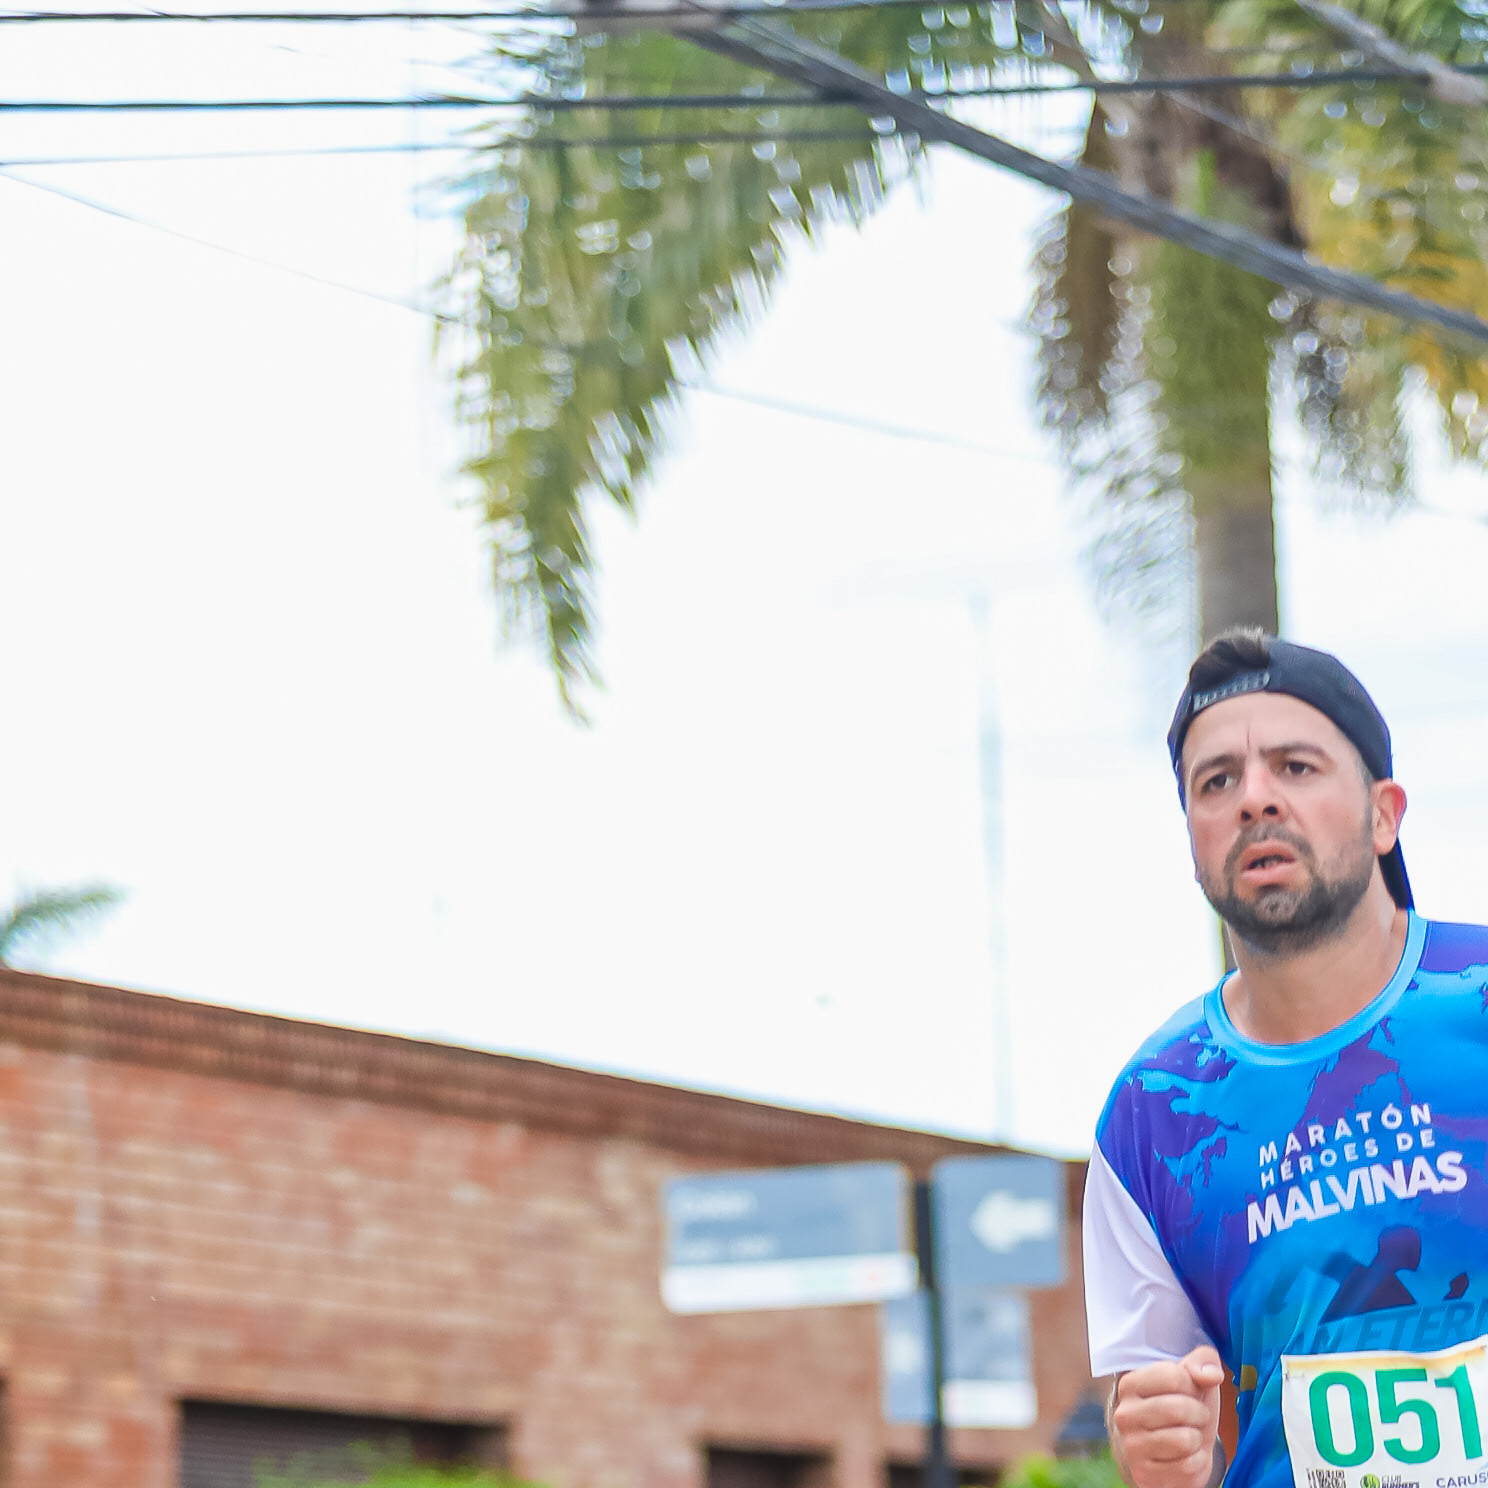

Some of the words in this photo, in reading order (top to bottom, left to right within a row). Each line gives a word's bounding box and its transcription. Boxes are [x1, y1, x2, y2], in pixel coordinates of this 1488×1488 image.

[1258, 1102, 1433, 1168] MARATÓN
[1260, 1137, 1379, 1190] HÉROES
[1395, 1128, 1436, 1152] DE
[1246, 1150, 1469, 1244] MALVINAS
[1308, 1363, 1484, 1468] 051
